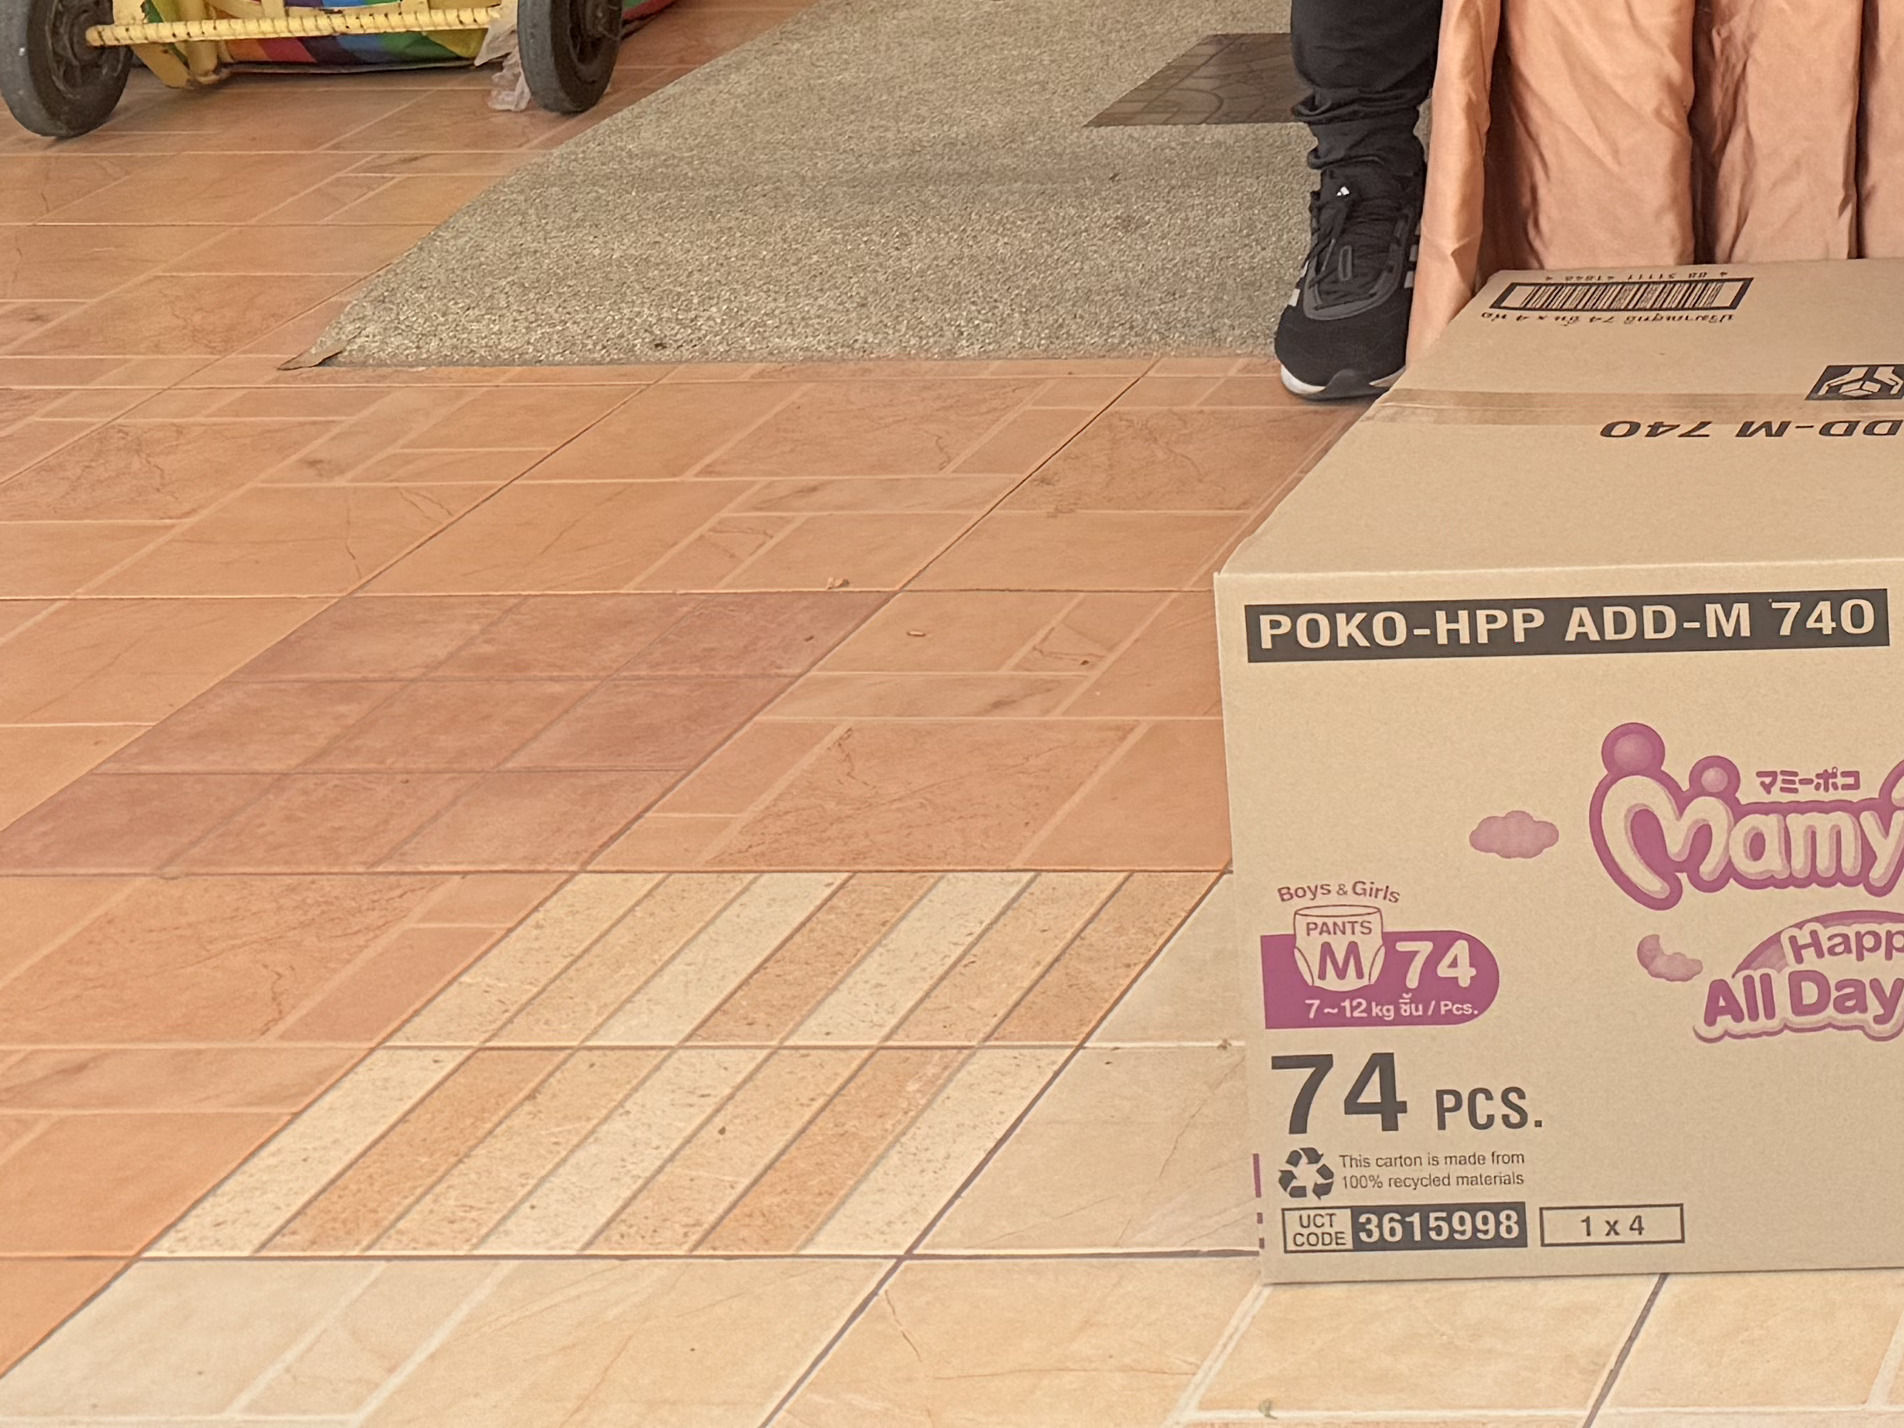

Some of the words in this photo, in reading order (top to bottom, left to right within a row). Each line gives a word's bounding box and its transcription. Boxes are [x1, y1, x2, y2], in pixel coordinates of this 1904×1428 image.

[1257, 607, 1546, 652] POKO-HPP
[1562, 601, 1754, 646] ADD-M
[1767, 596, 1878, 640] 740
[1756, 768, 1861, 794] マミーポコ
[1278, 880, 1333, 904] Boys
[1350, 880, 1402, 905] Girls
[1305, 918, 1373, 938] PANTS
[1317, 942, 1365, 981] M
[1704, 973, 1775, 1027] All
[1270, 1052, 1408, 1136] 74
[1435, 1086, 1544, 1131] PCS.
[1338, 1151, 1373, 1169] This
[1375, 1150, 1423, 1170] carton
[1425, 1150, 1440, 1168] is
[1443, 1148, 1487, 1167] made
[1489, 1148, 1526, 1166] from
[1340, 1173, 1384, 1190] 100%
[1386, 1171, 1452, 1191] recycled
[1455, 1169, 1526, 1189] materials
[1291, 1230, 1348, 1249] CODE
[1357, 1209, 1521, 1244] 3615998
[1299, 1212, 1338, 1230] UCT
